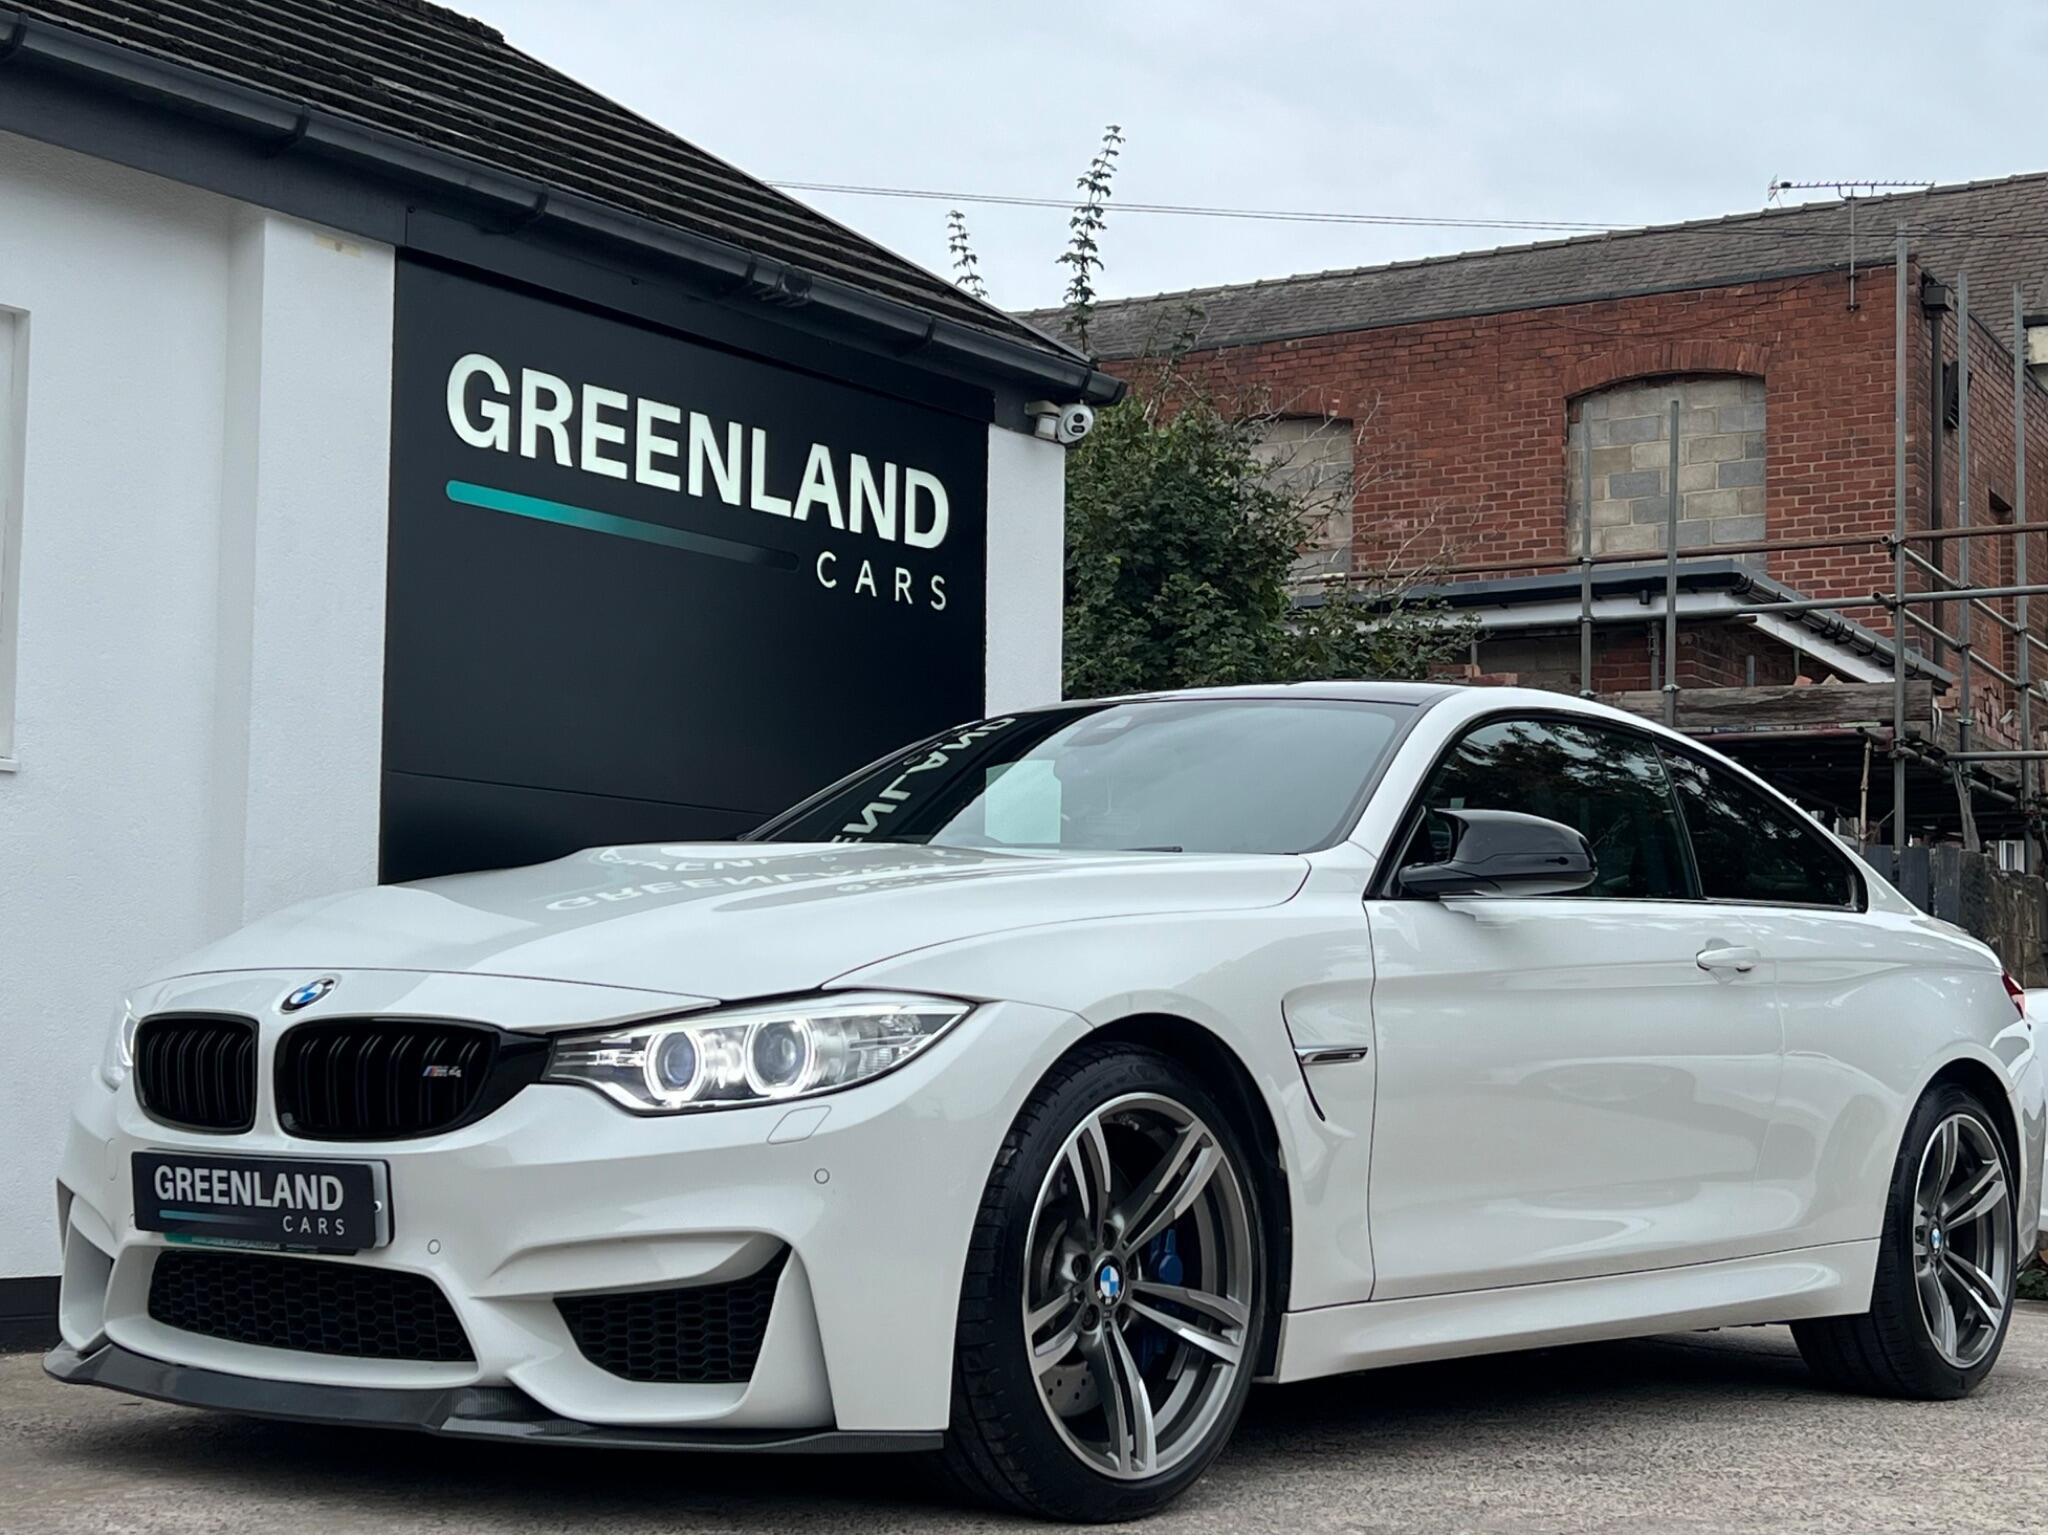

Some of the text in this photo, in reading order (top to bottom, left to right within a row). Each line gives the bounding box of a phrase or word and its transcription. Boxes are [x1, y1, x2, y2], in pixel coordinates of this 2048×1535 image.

[446, 353, 950, 550] GREENLAND
[816, 550, 948, 612] CARS
[154, 1165, 344, 1212] GREENLAND
[282, 1214, 345, 1236] CARS
